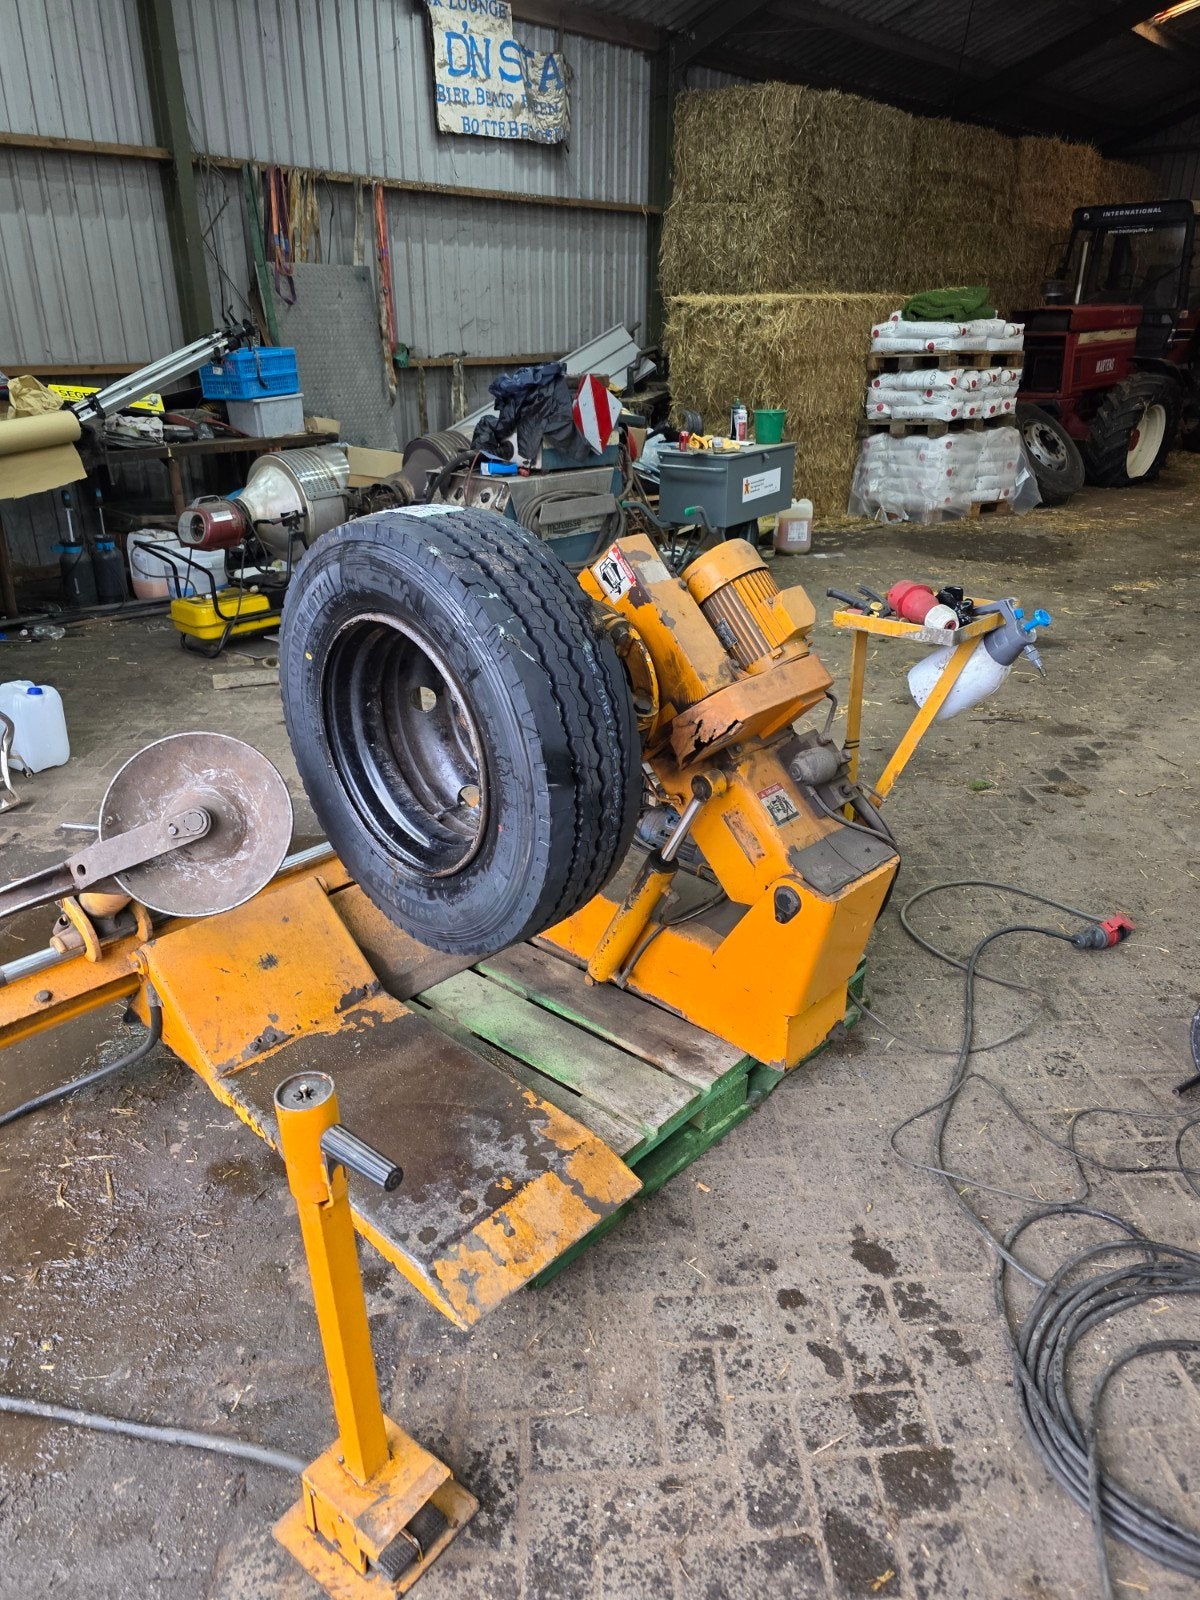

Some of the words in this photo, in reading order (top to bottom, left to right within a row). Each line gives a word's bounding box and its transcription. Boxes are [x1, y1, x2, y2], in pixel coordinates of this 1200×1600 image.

[450, 0, 507, 19] LOUNGE
[475, 87, 514, 109] BEATS
[1103, 207, 1162, 217] INTERNATIONAL
